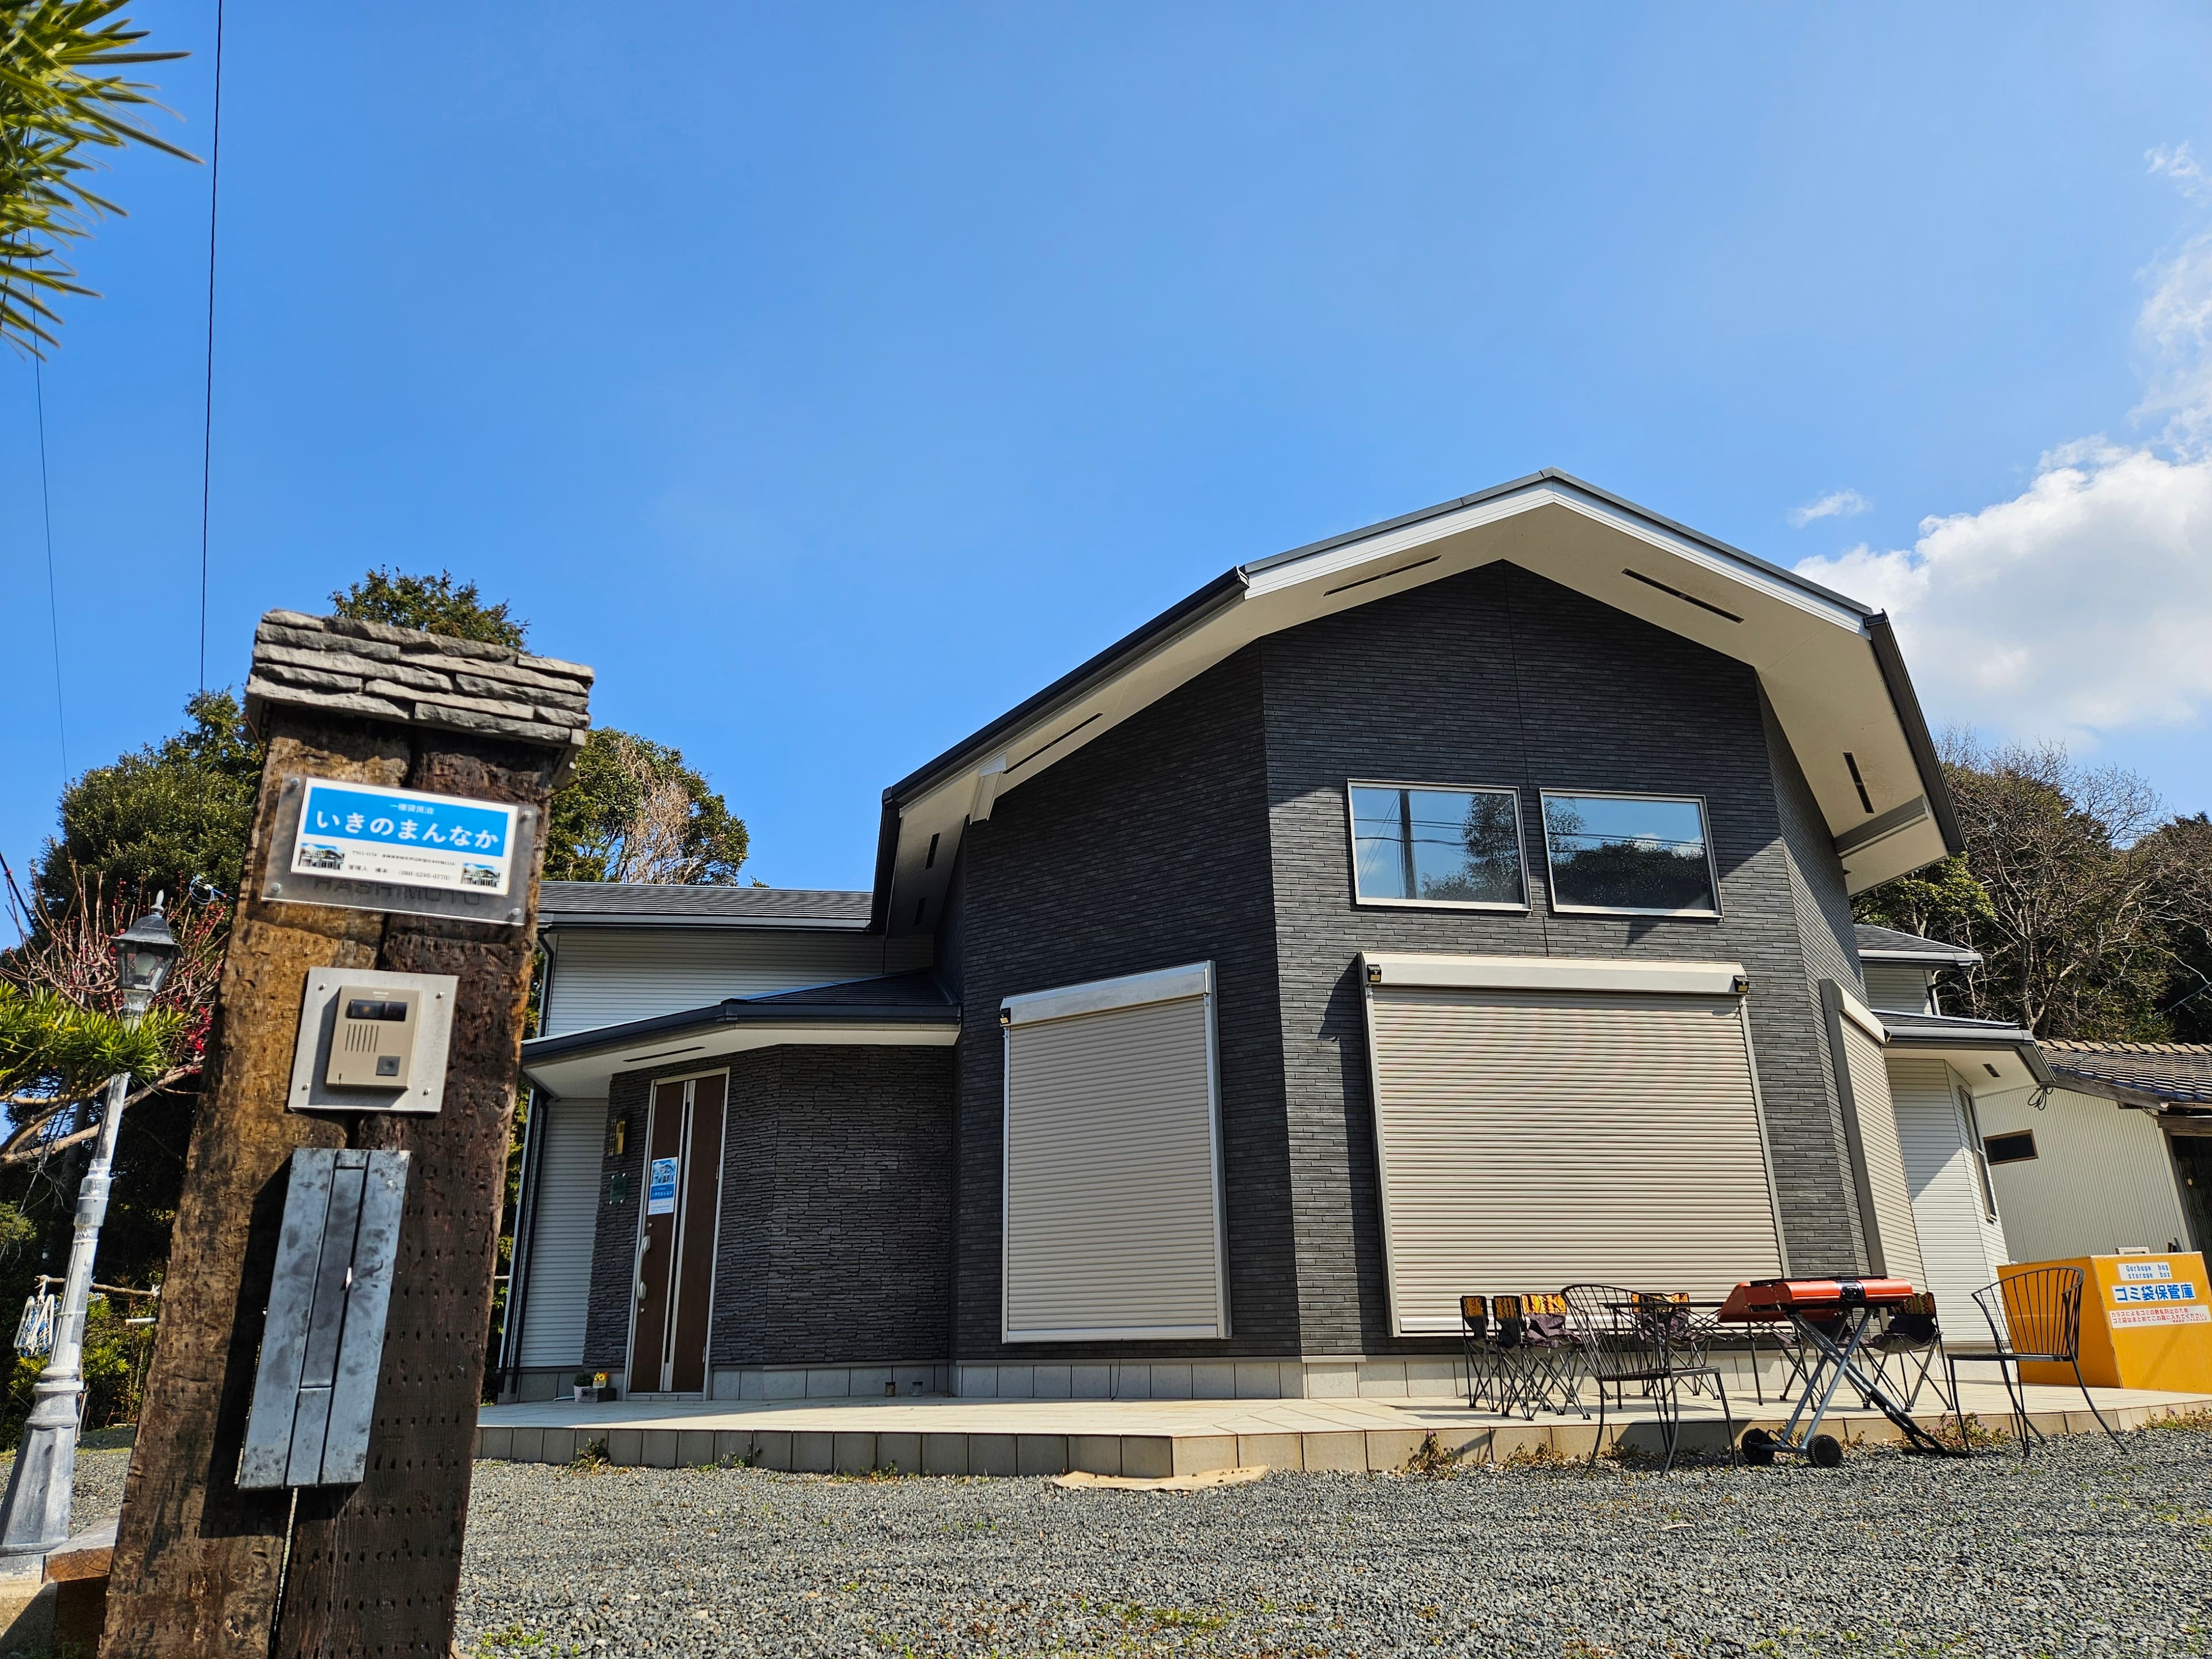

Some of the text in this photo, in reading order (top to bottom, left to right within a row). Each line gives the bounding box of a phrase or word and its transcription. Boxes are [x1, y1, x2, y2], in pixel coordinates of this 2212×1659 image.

[316, 810, 499, 850] いきのまんなか
[2115, 1283, 2195, 1301] ゴミ袋保管庫
